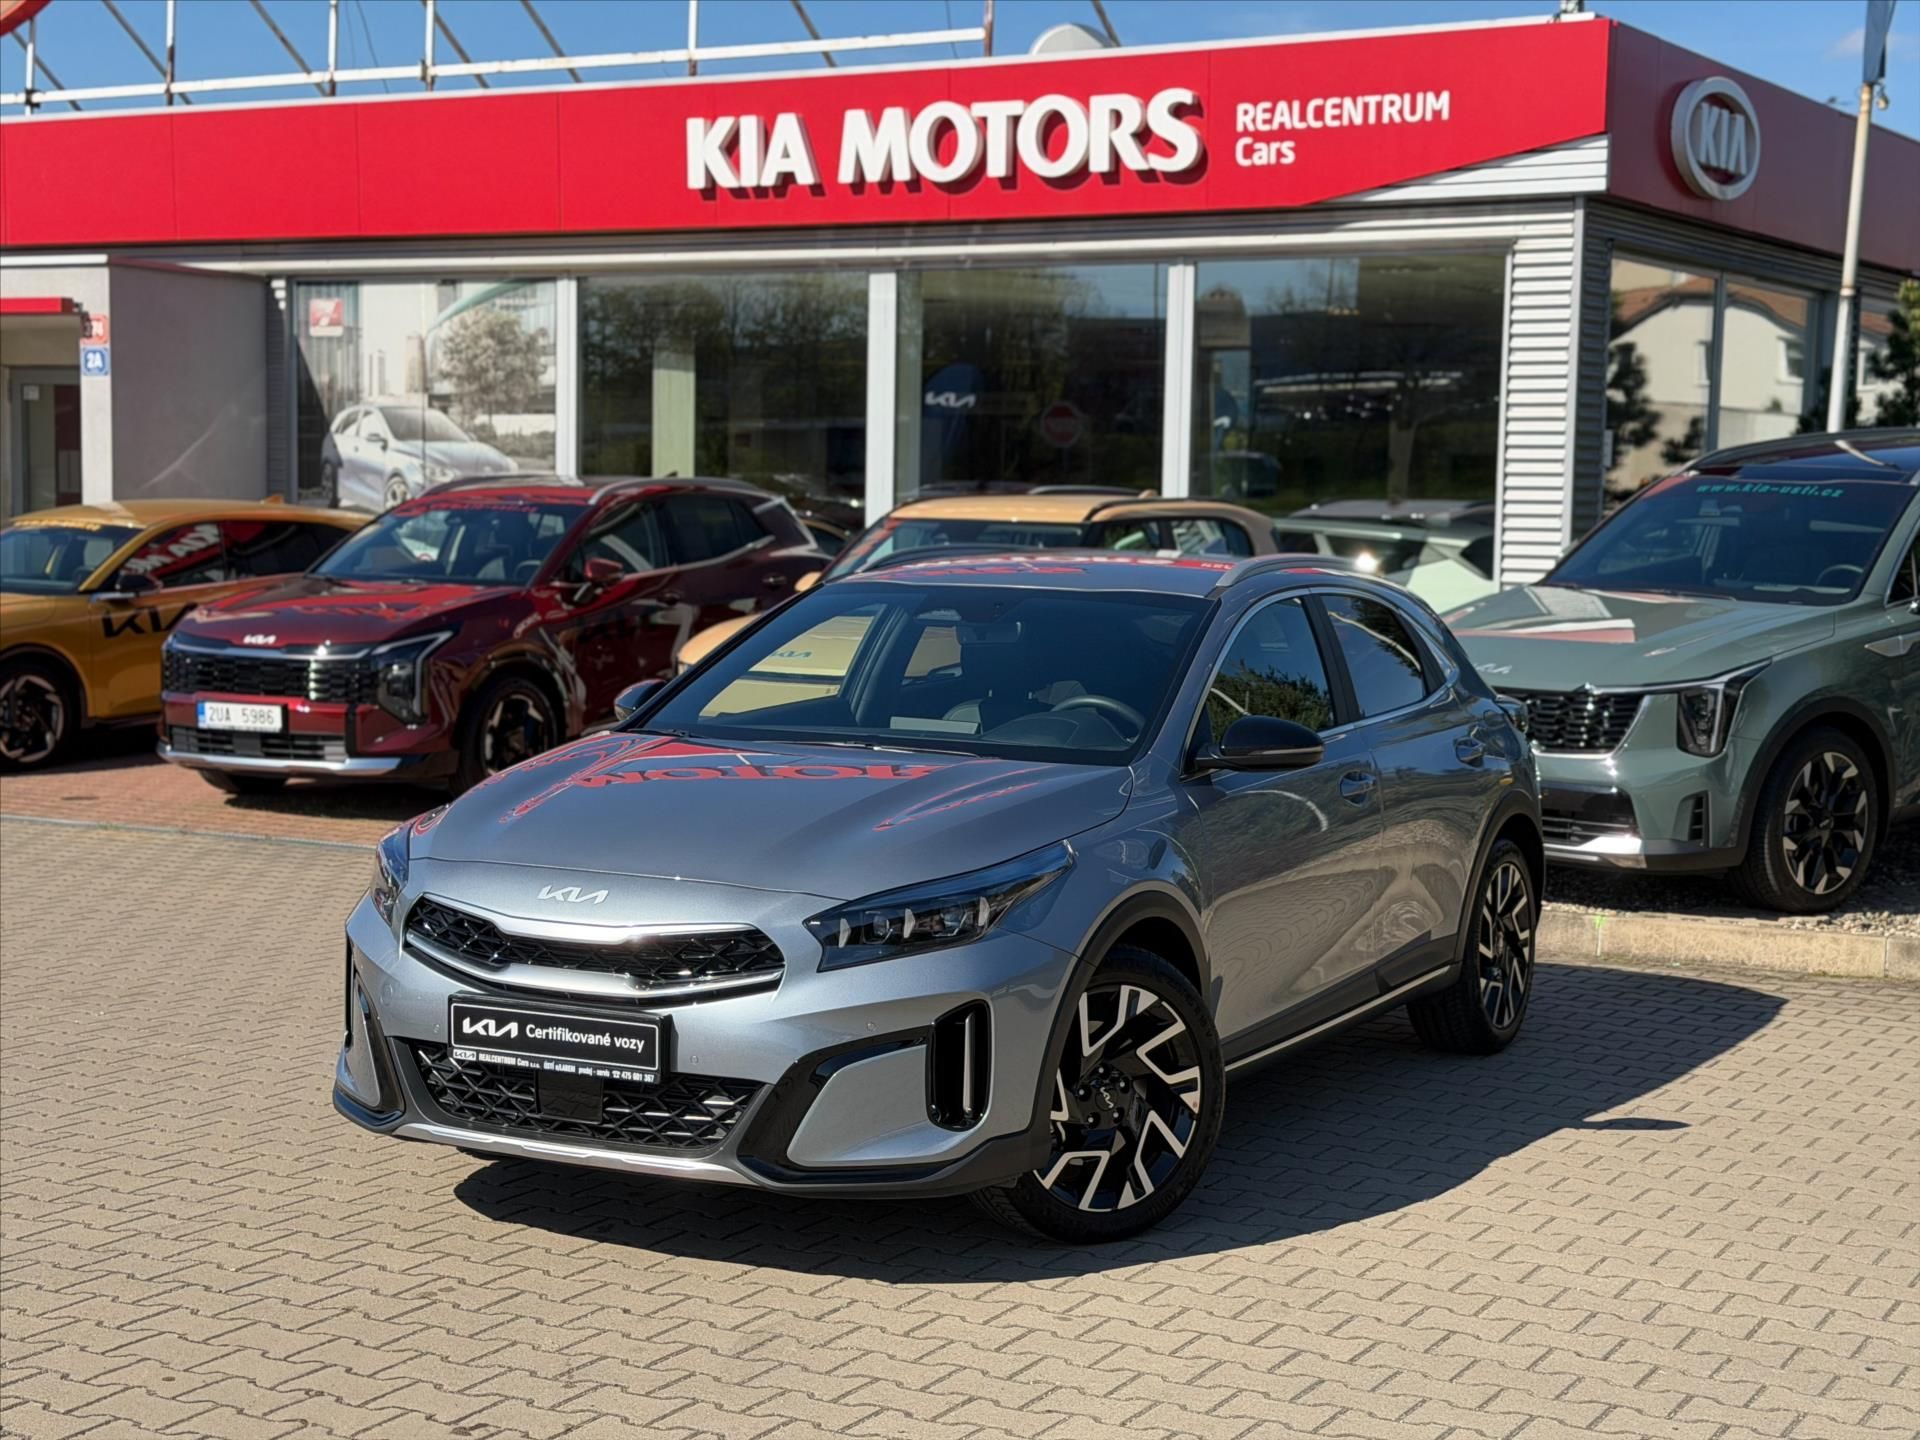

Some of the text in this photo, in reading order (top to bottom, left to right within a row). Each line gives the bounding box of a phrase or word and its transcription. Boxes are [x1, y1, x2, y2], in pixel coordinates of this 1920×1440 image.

[1236, 90, 1450, 133] REALCENTRUM
[686, 88, 1201, 190] KIA MOTORS
[1235, 136, 1296, 167] Cars
[1698, 101, 1748, 176] KIA
[86, 351, 104, 369] 2A
[1696, 483, 1844, 497] www.kia-usti.cz
[208, 706, 232, 722] 2UA
[241, 708, 275, 724] 5986
[537, 884, 609, 904] KIA
[462, 1017, 645, 1053] KIA Certifikované vozy
